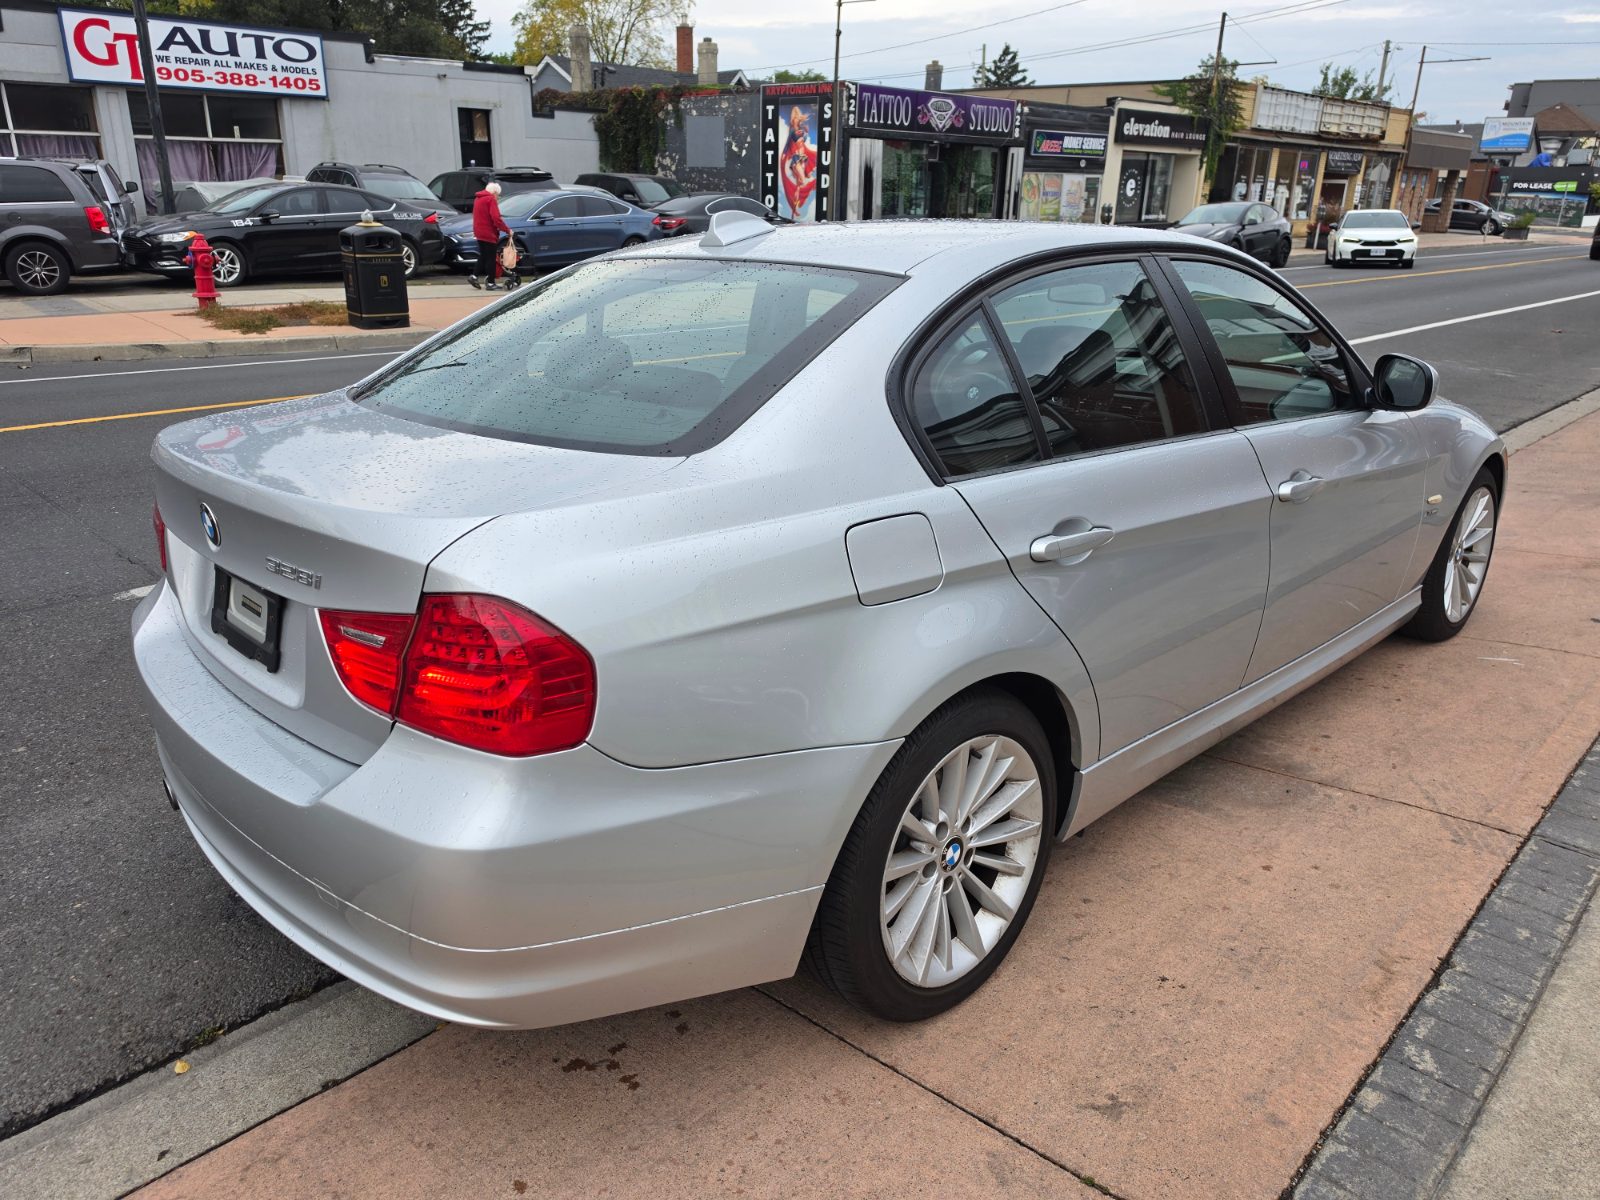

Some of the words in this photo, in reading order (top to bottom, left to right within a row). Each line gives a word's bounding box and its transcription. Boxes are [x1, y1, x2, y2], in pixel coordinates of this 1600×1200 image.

[73, 17, 146, 80] GT
[156, 26, 317, 63] AUTO
[155, 54, 172, 64] WE
[174, 56, 211, 67] REPAIR
[214, 59, 232, 69] ALL
[234, 61, 268, 72] MAKES
[271, 64, 278, 73] &
[281, 65, 317, 76] MODELS
[156, 66, 321, 92] 905-388-1405
[765, 84, 816, 96] KRYPTONIAN
[848, 83, 856, 126] 428
[863, 92, 912, 127] TATTOO
[969, 104, 1012, 133] STUDIO
[1123, 117, 1171, 138] elevation
[1171, 131, 1185, 139] HAIR
[1185, 133, 1206, 141] LOUNGE
[1063, 136, 1084, 149] MONEY
[1082, 137, 1106, 150] SERVICE
[821, 103, 832, 221] STUDI
[1529, 182, 1553, 190] LEASE
[265, 556, 322, 590] 328i
